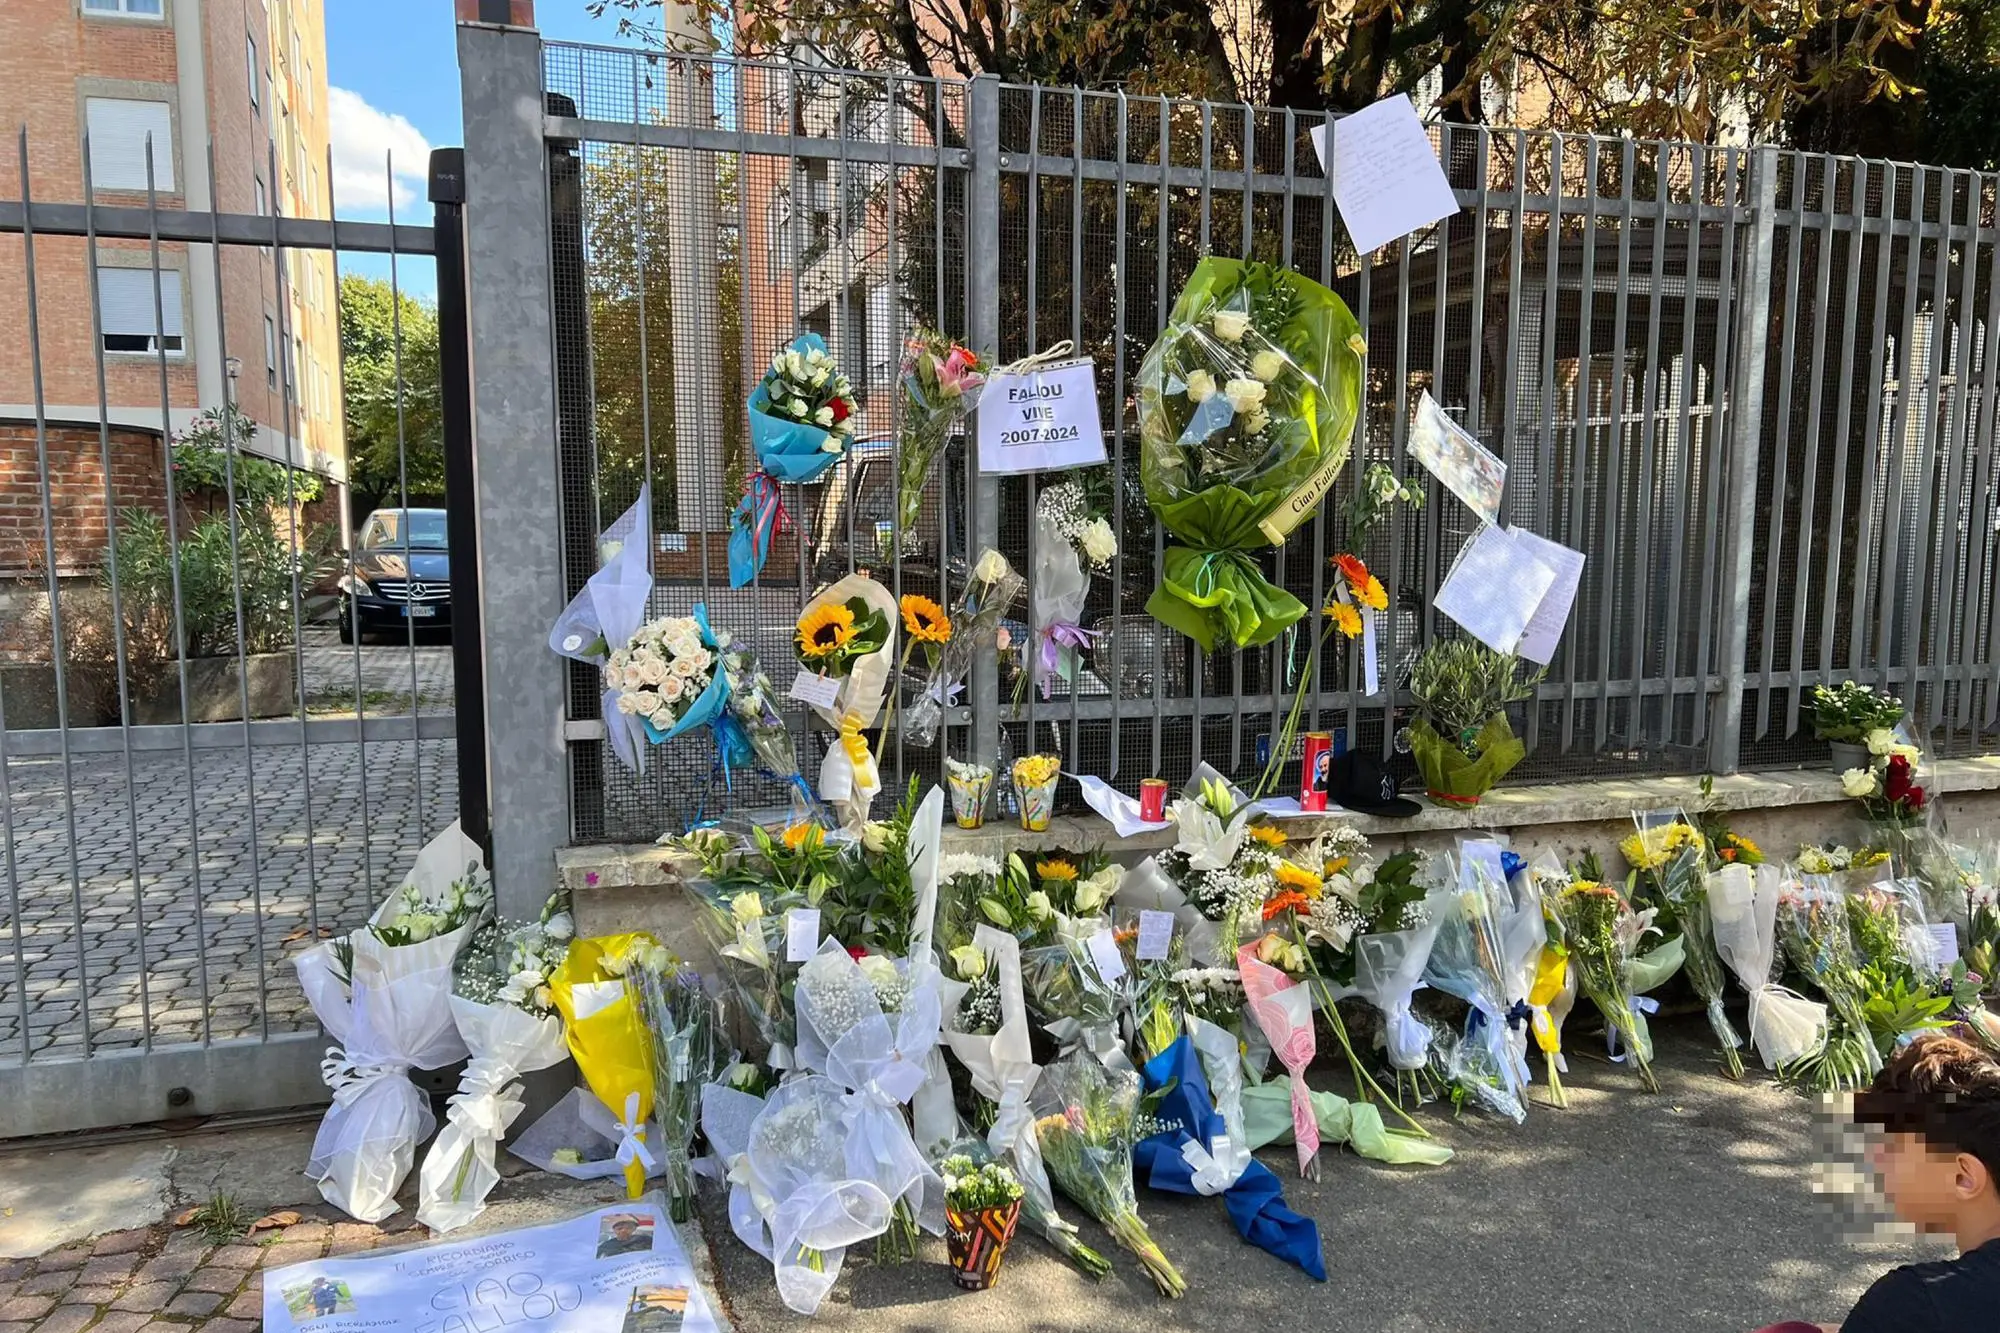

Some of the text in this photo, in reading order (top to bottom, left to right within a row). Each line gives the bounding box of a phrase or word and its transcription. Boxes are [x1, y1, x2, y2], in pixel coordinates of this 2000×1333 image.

[1009, 384, 1063, 400] FALLOU
[1022, 407, 1053, 420] VIVE
[1001, 426, 1078, 444] 2007-2024
[1292, 460, 1341, 513] Ciao Fallou
[427, 1241, 515, 1264] RICORDIAMO
[473, 1251, 536, 1272] SORRISO
[431, 1272, 543, 1311] CIAO
